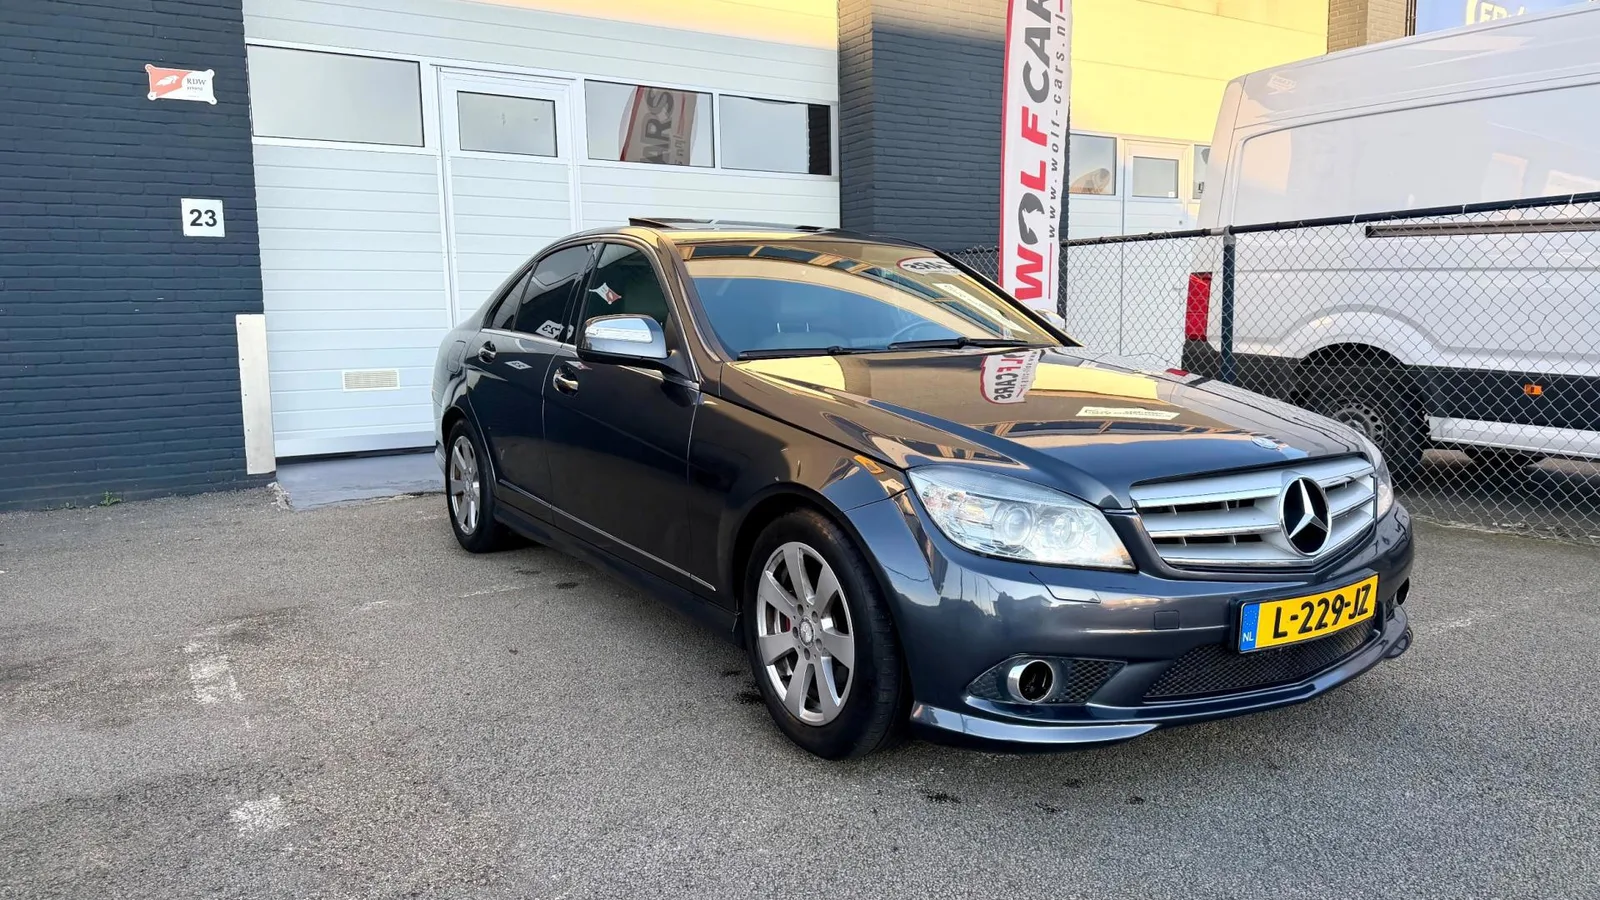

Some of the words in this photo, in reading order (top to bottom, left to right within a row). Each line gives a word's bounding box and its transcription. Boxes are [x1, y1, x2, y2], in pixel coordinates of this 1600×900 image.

[1049, 13, 1066, 239] www.wolf-cars.nl
[189, 208, 217, 227] 23
[1273, 584, 1371, 639] L-229-JZ
[1242, 632, 1254, 642] NL
